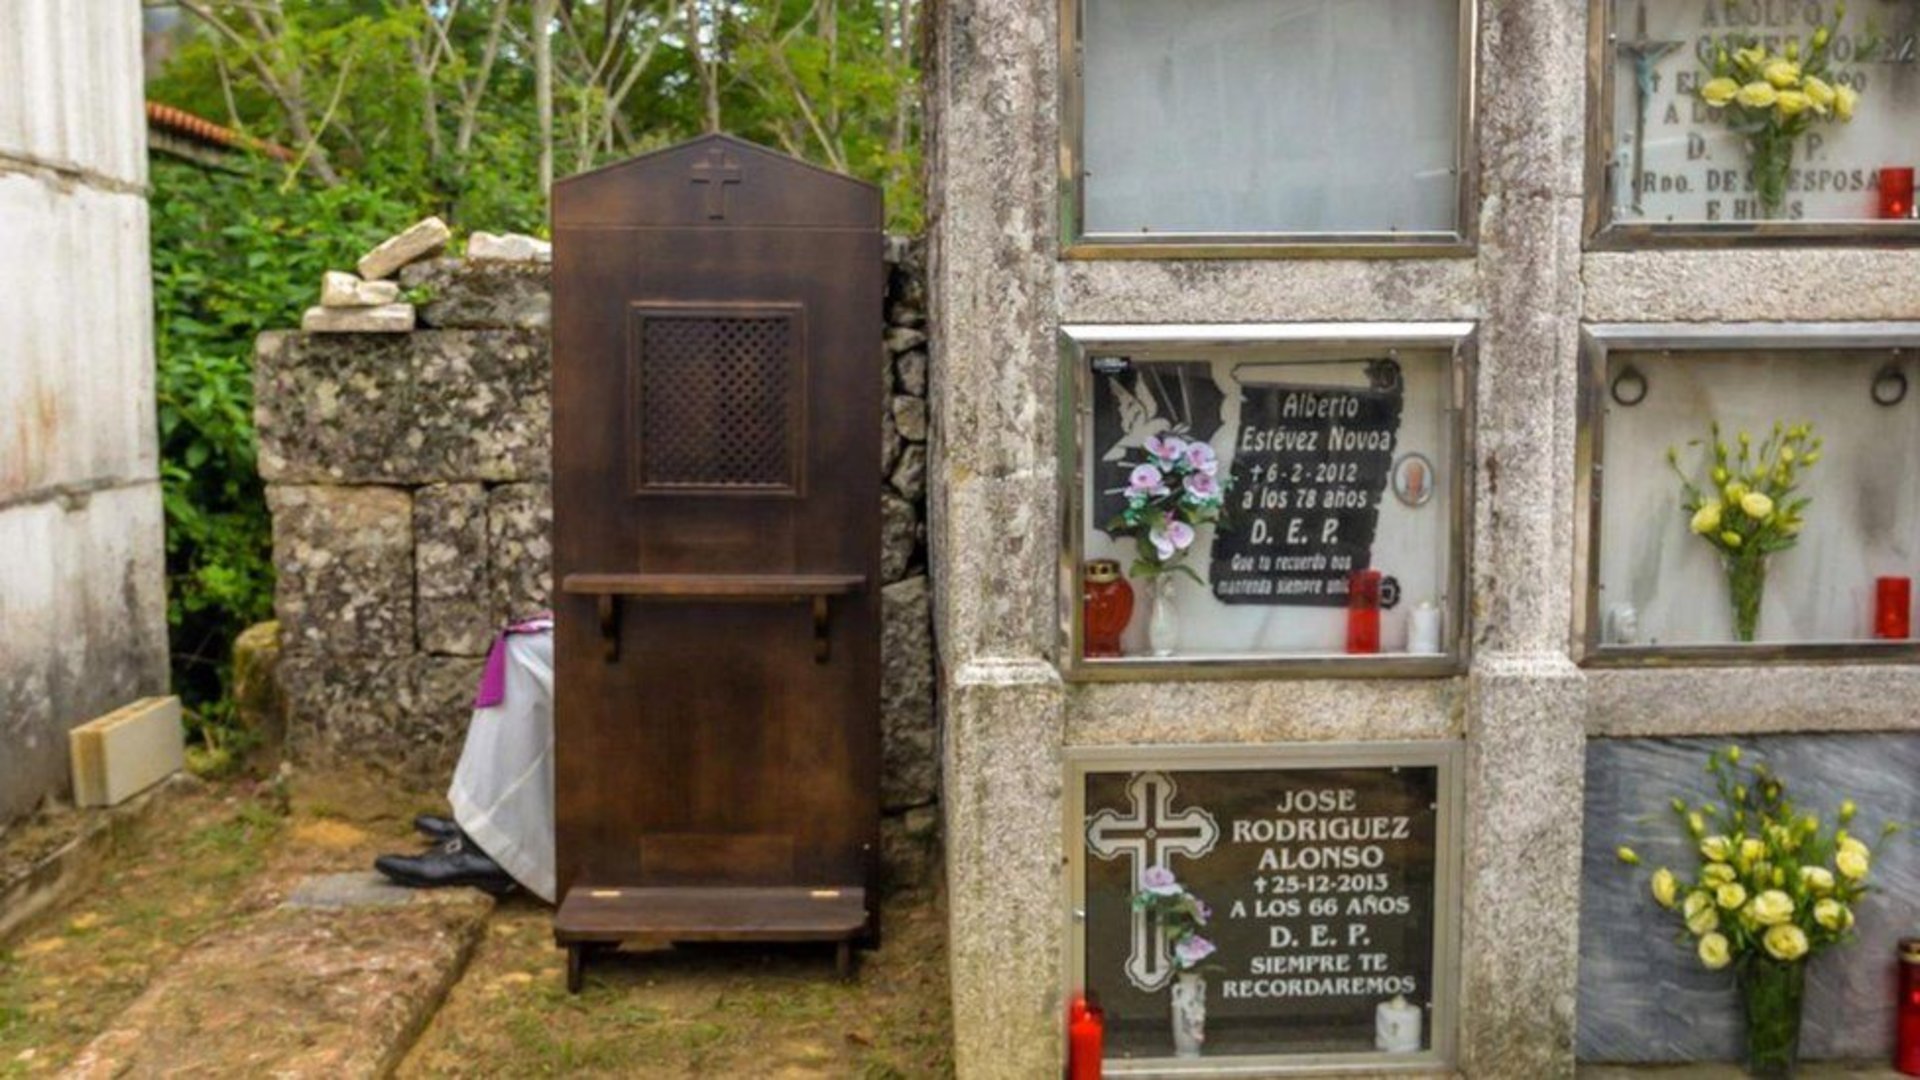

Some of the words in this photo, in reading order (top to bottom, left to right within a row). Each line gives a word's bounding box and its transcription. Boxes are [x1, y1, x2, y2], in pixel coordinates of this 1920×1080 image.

[1663, 103, 1680, 124] A
[1686, 133, 1711, 161] D.
[1805, 132, 1827, 161] P.
[1706, 169, 1738, 192] DE
[1787, 169, 1881, 192] ESPOSA
[1706, 200, 1720, 220] E
[1282, 392, 1359, 418] Alberto
[1241, 425, 1319, 452] Estévez
[1328, 426, 1392, 451] Novoa
[1242, 490, 1254, 509] a
[1260, 487, 1288, 509] los
[1296, 488, 1317, 509] 78
[1323, 484, 1368, 509] años
[1251, 518, 1273, 544] D.
[1286, 518, 1308, 544] E.
[1321, 518, 1339, 544] P.
[1231, 552, 1254, 571] Que
[1275, 552, 1327, 571] recuerdo
[1277, 789, 1356, 813] JOSE
[1232, 816, 1410, 843] RODRIGUEZ
[1258, 845, 1384, 870] ALONSO
[1272, 873, 1388, 894] 25-12-2013
[1230, 900, 1247, 918] A
[1255, 899, 1301, 917] LOS
[1309, 898, 1338, 916] 66
[1346, 894, 1410, 915] AÑOS
[1270, 925, 1299, 948] D.
[1310, 924, 1337, 947] E.
[1348, 923, 1371, 946] P.
[1250, 953, 1351, 974] SIEMPRE
[1358, 953, 1388, 972] TE
[1222, 975, 1416, 998] RECORDAREMOS
